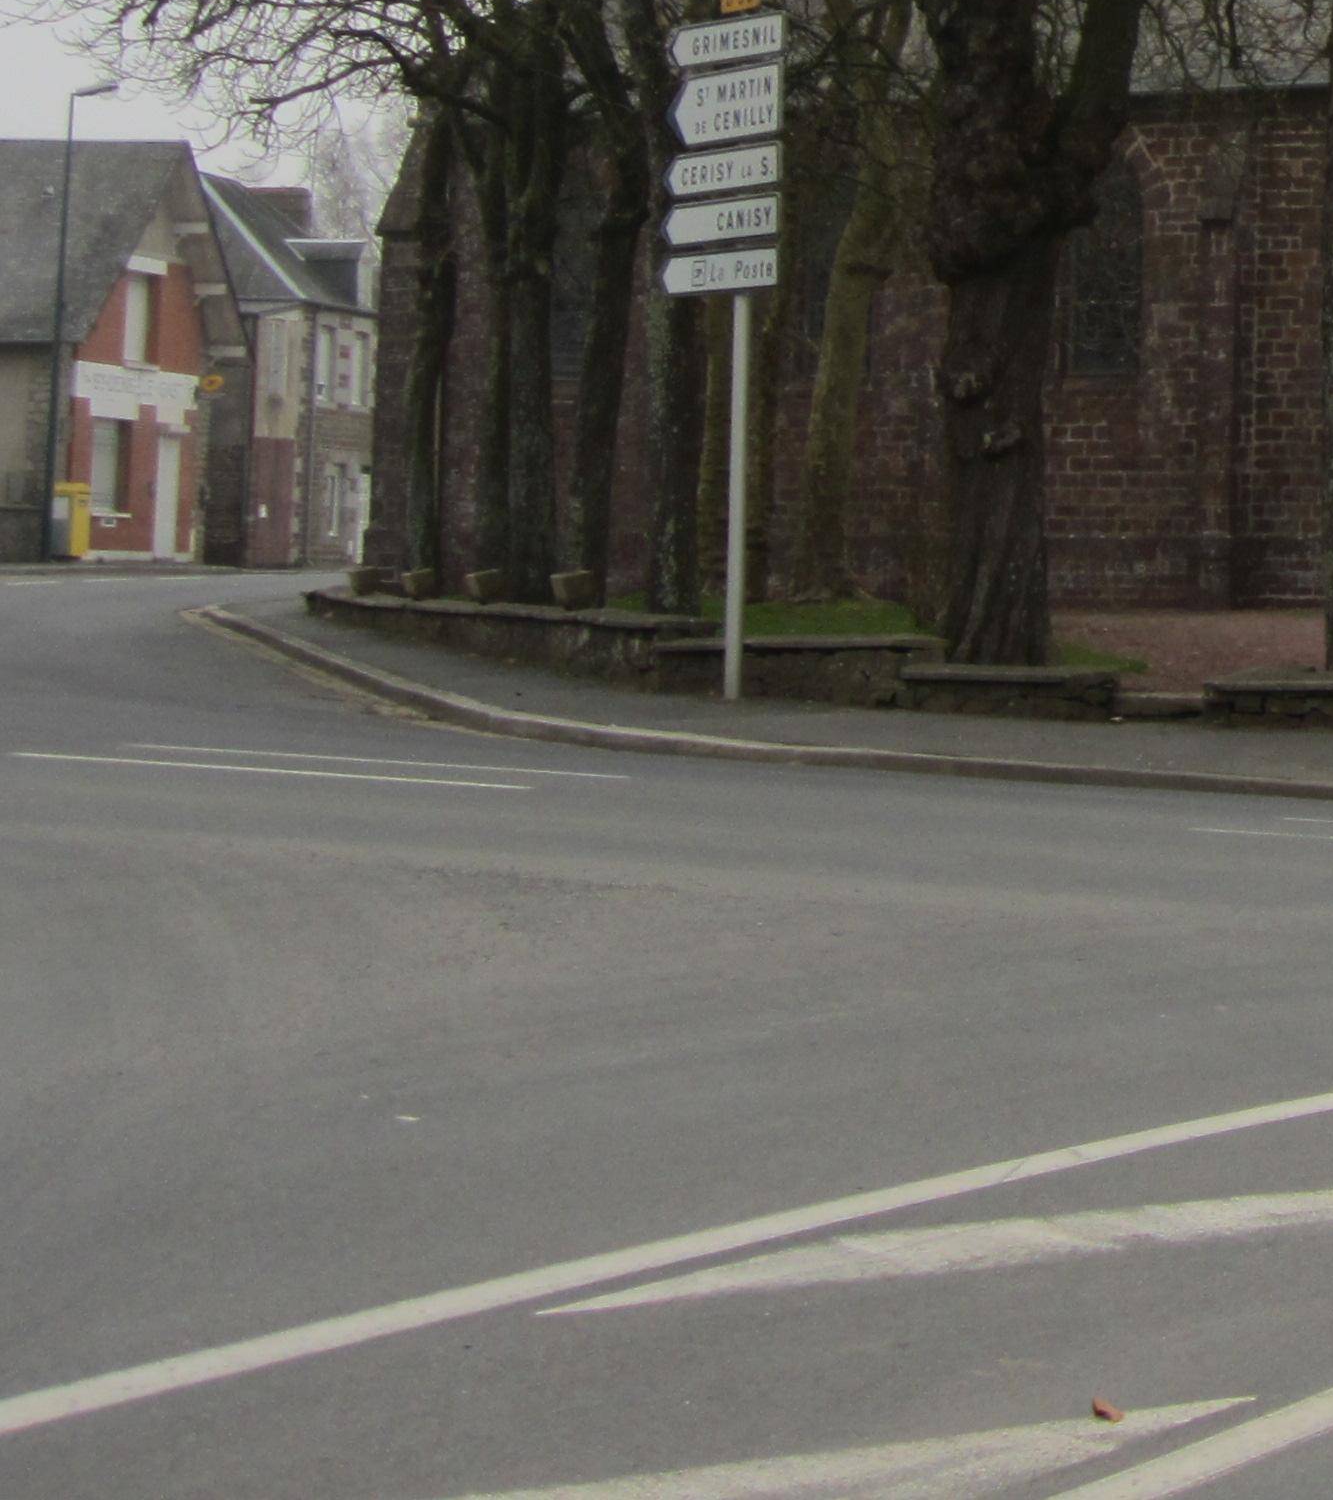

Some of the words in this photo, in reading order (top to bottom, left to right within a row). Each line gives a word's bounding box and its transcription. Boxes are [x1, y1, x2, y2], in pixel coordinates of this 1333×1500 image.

[692, 24, 776, 56] GRIMESNIL
[718, 76, 772, 102] MARTIN
[695, 121, 706, 135] DE
[713, 103, 774, 132] CENILLY
[681, 160, 734, 187] CERISY
[760, 156, 774, 177] S.
[716, 205, 772, 231] CANISY
[706, 263, 724, 282] La
[734, 260, 774, 280] Poste
